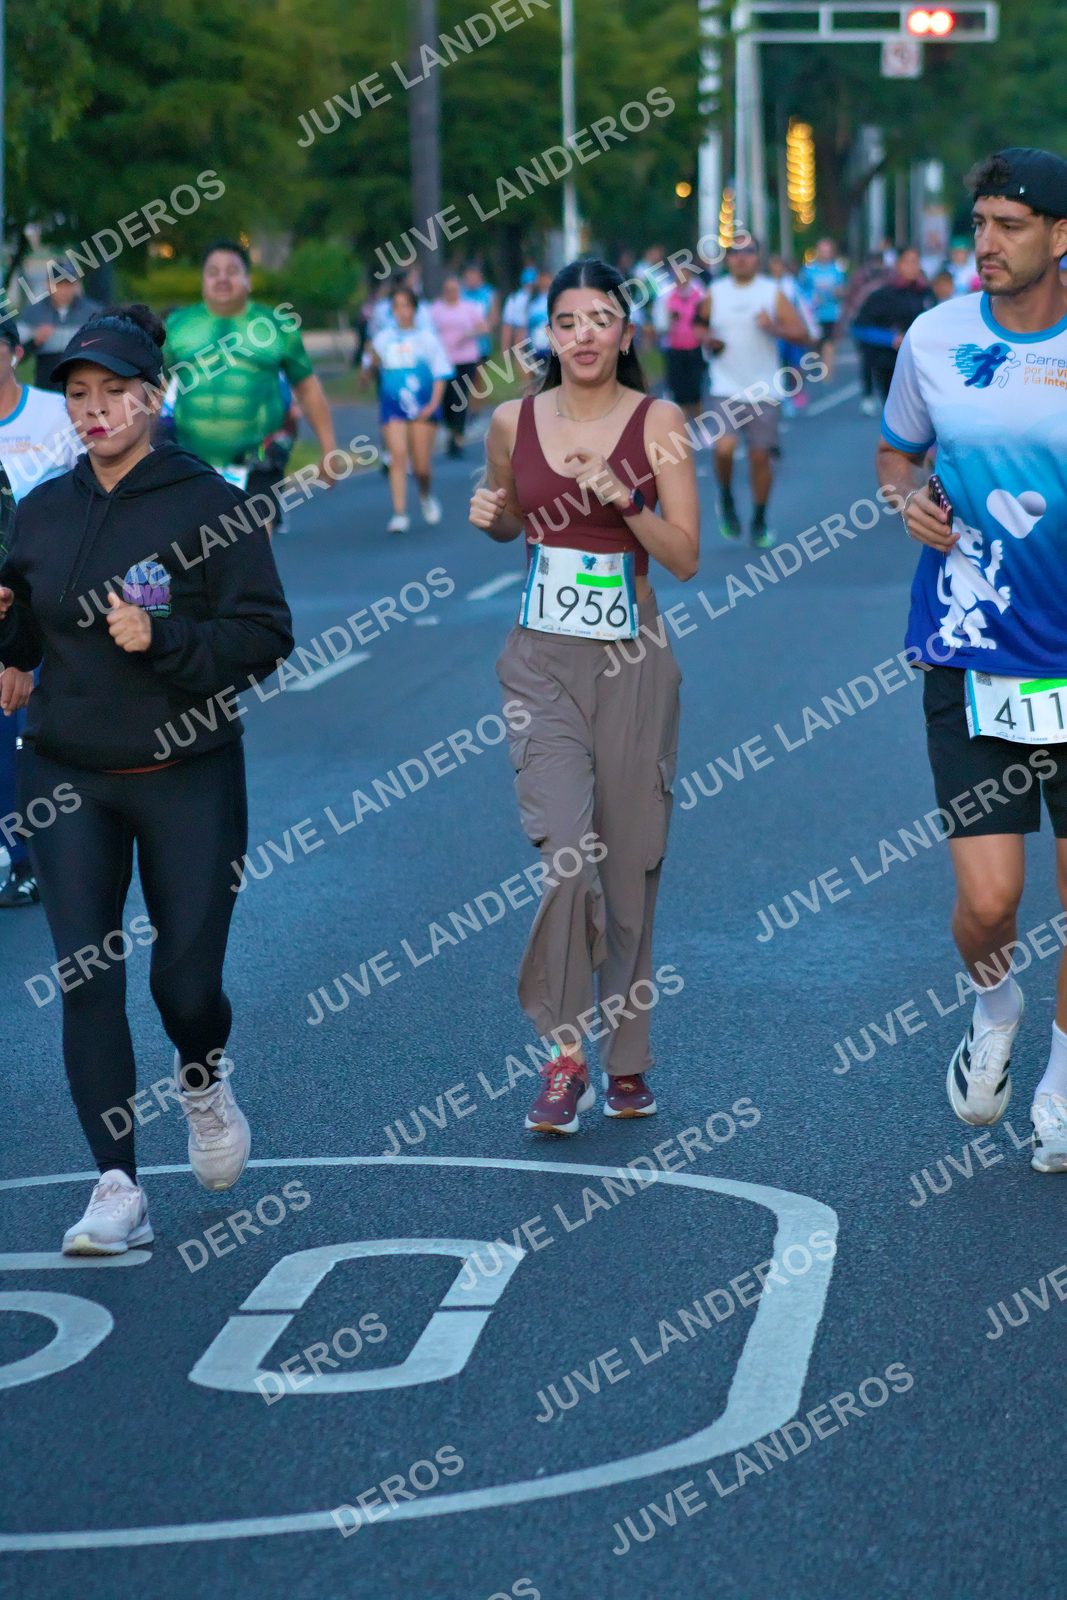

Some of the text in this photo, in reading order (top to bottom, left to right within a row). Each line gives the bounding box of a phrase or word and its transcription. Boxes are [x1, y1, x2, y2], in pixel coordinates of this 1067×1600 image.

[1025, 353, 1067, 369] Carre
[537, 583, 627, 628] 1956
[993, 692, 1064, 733] 411
